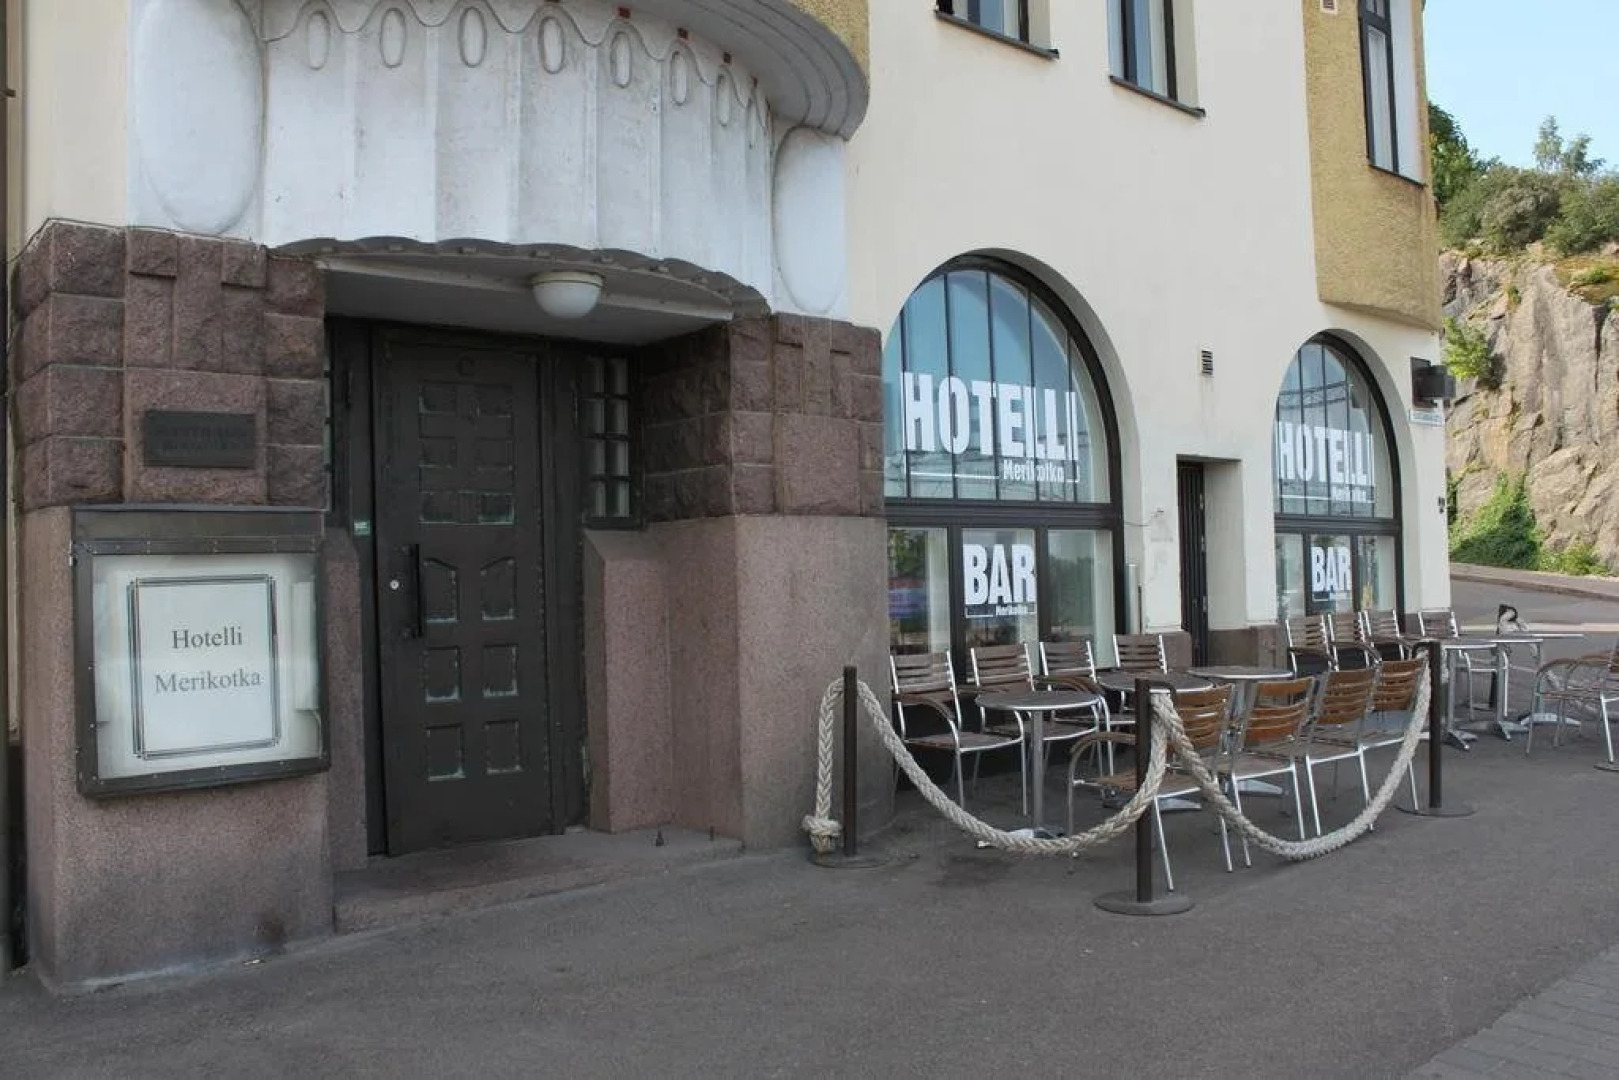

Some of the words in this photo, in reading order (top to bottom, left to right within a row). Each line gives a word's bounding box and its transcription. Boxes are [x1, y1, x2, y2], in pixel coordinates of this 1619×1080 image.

[902, 373, 1078, 461] HOTELLI
[1278, 421, 1375, 485] HOTELLI
[963, 543, 1037, 605] BAR
[1312, 546, 1351, 592] BAR
[172, 626, 242, 649] Hotelli
[155, 669, 262, 694] Merikotka
